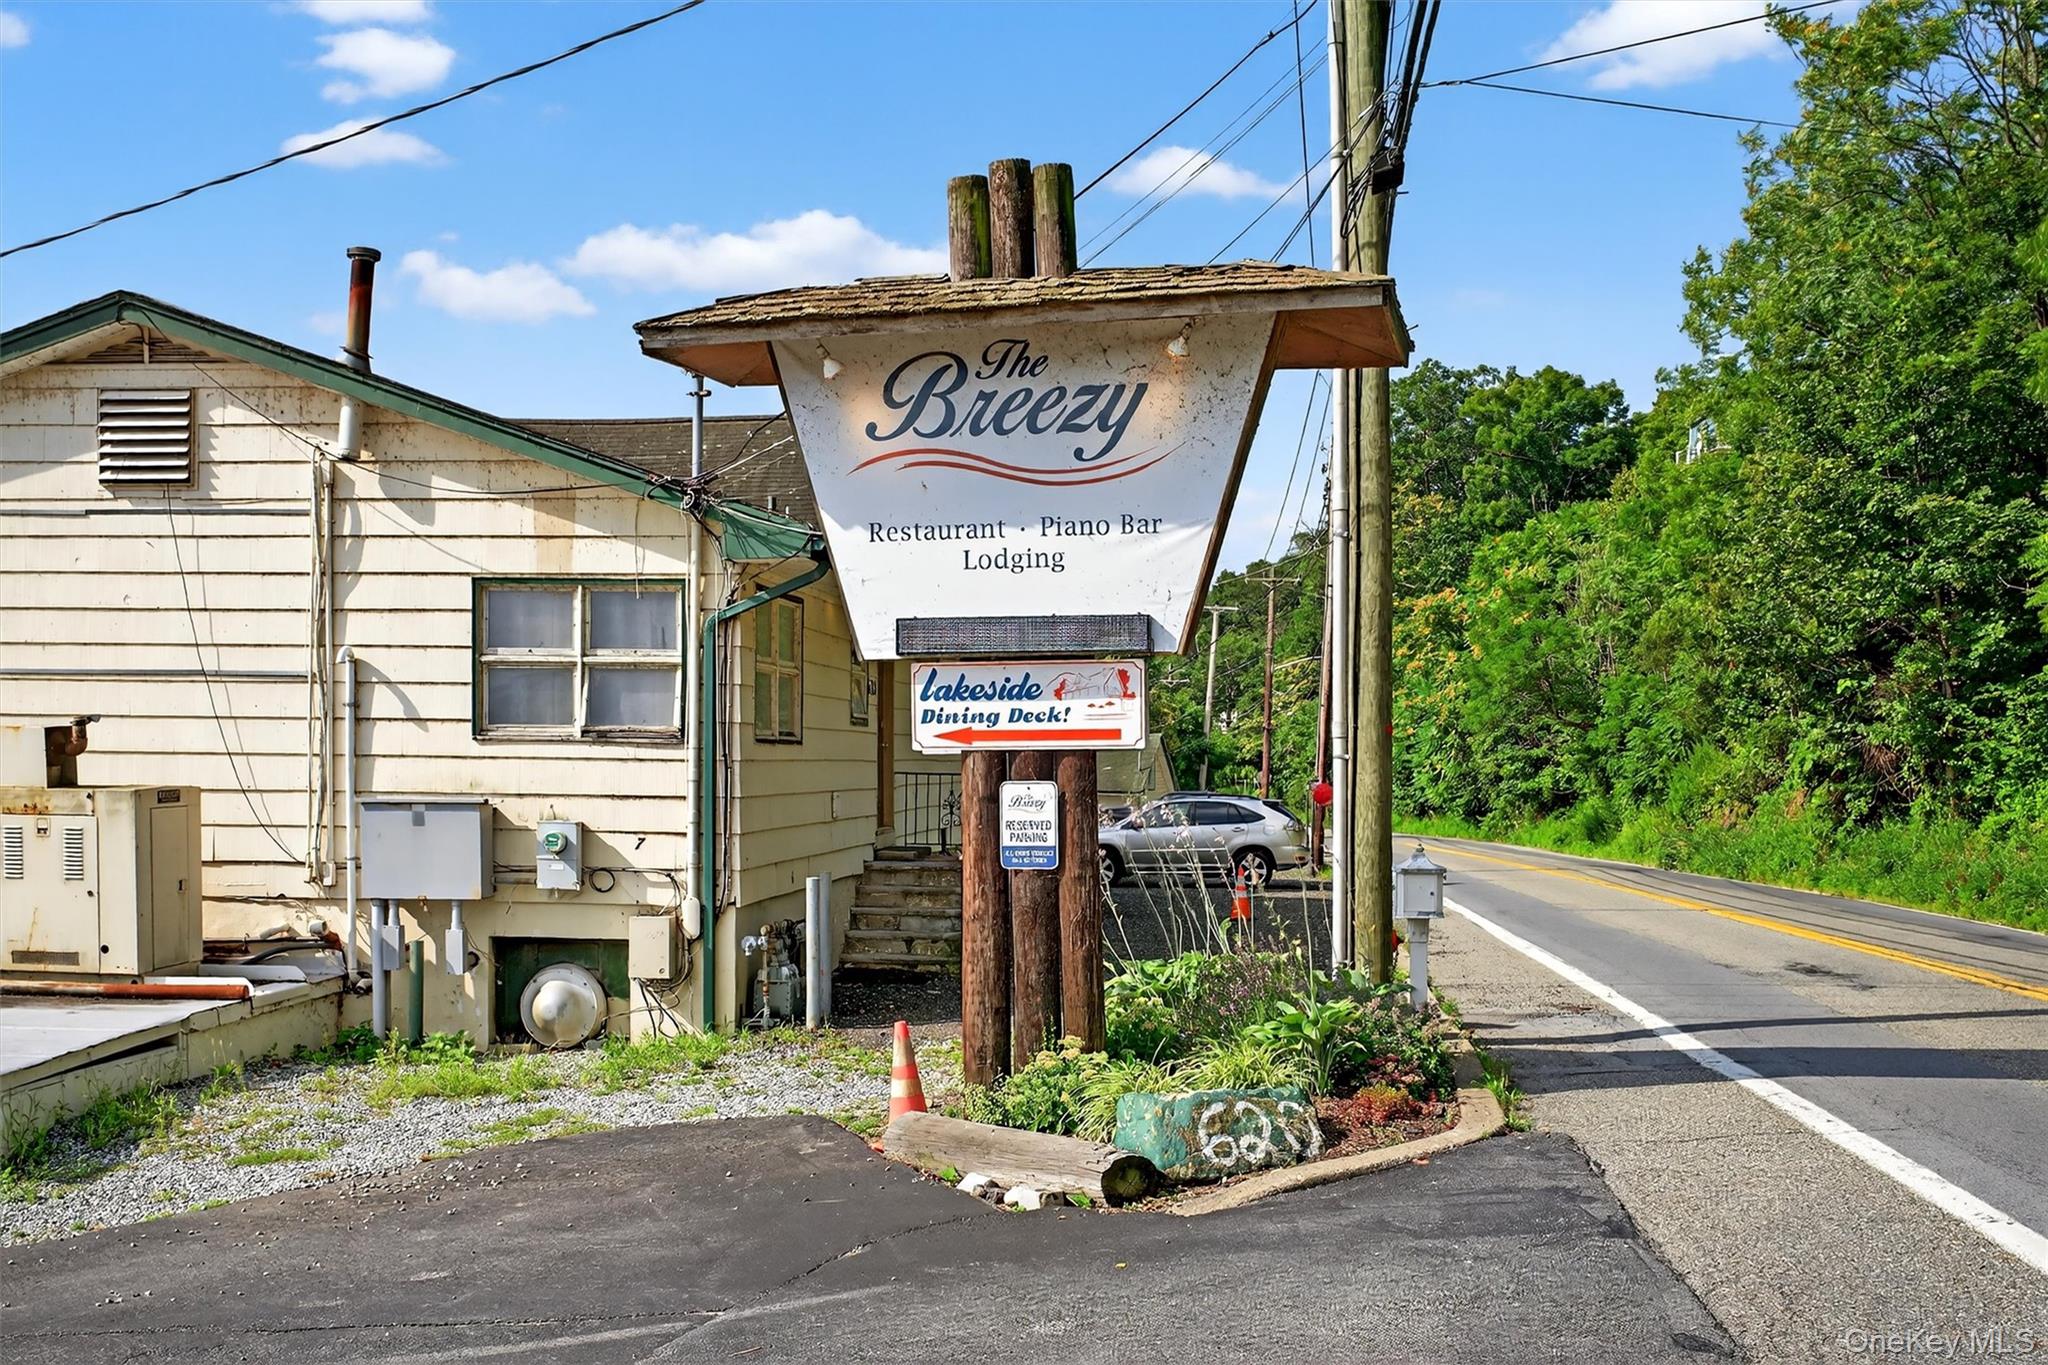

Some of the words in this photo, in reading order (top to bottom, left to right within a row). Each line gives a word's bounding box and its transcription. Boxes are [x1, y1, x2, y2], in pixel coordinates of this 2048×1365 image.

[975, 338, 1048, 379] The
[865, 351, 1149, 462] Breezy
[868, 520, 1006, 543] Restaurant
[1040, 516, 1110, 537] Piano
[1120, 514, 1163, 535] Bar
[963, 548, 1066, 573] Lodging
[921, 706, 1000, 727] Dining
[1008, 706, 1071, 723] Deck!
[1005, 820, 1052, 831] RESERVED
[1009, 832, 1048, 843] PARKING
